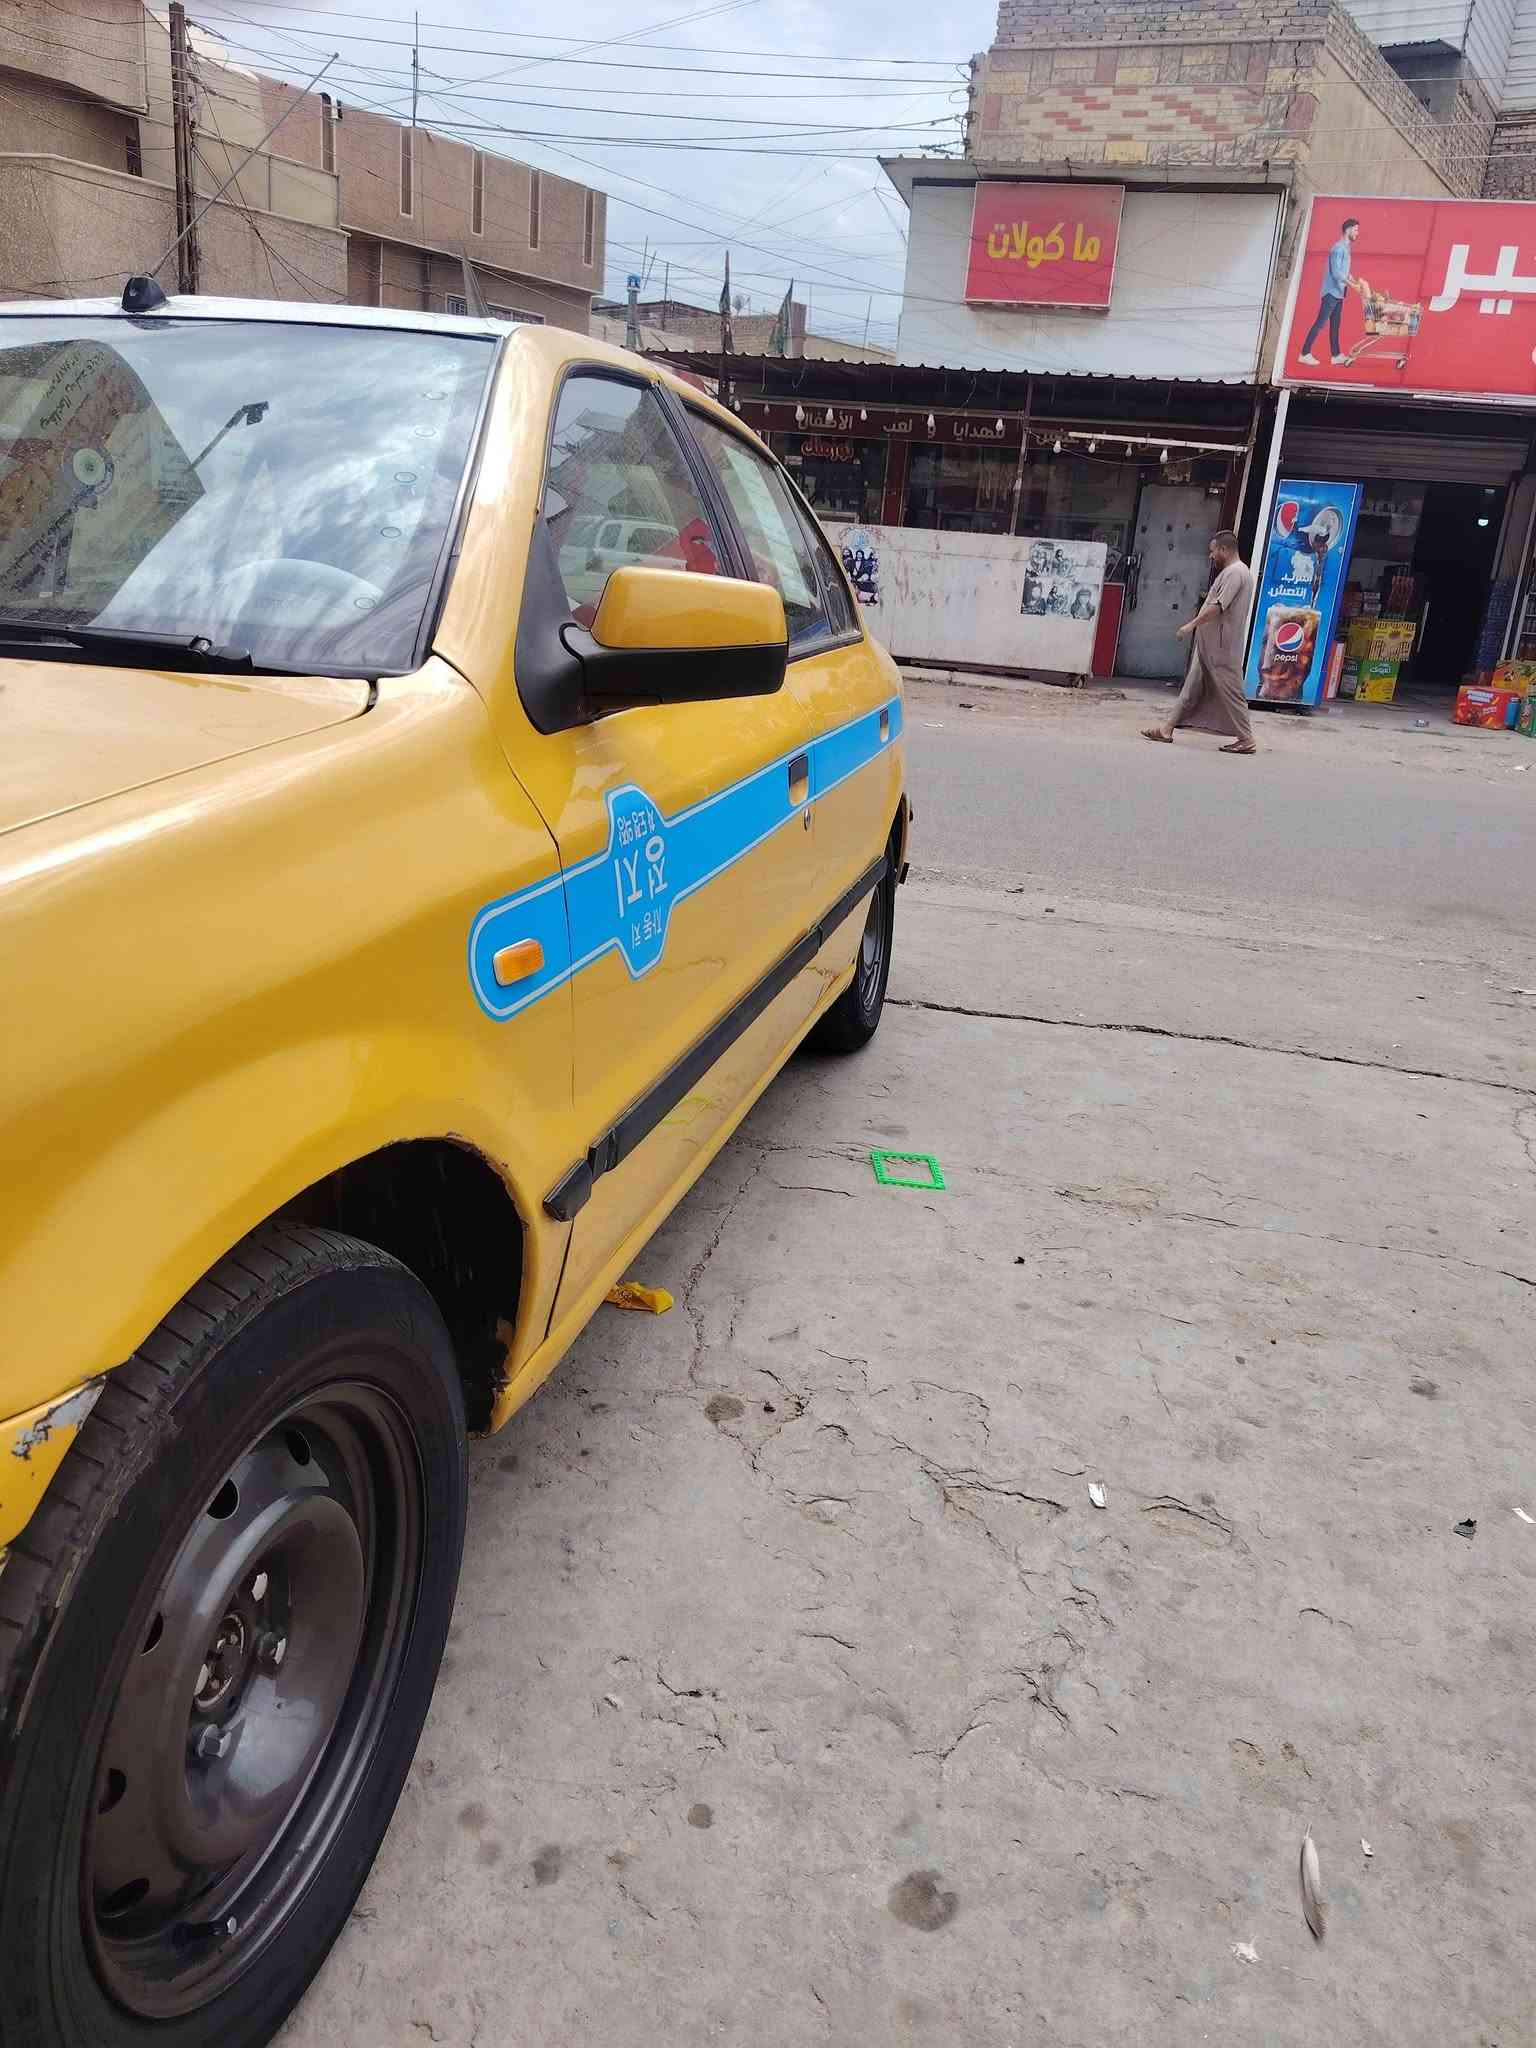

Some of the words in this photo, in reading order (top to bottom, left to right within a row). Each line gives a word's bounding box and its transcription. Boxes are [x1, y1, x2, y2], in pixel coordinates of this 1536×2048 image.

[987, 220, 1065, 269] كولات
[1072, 223, 1101, 262] ما
[882, 418, 912, 437] لعب
[1273, 654, 1298, 663] pepsi
